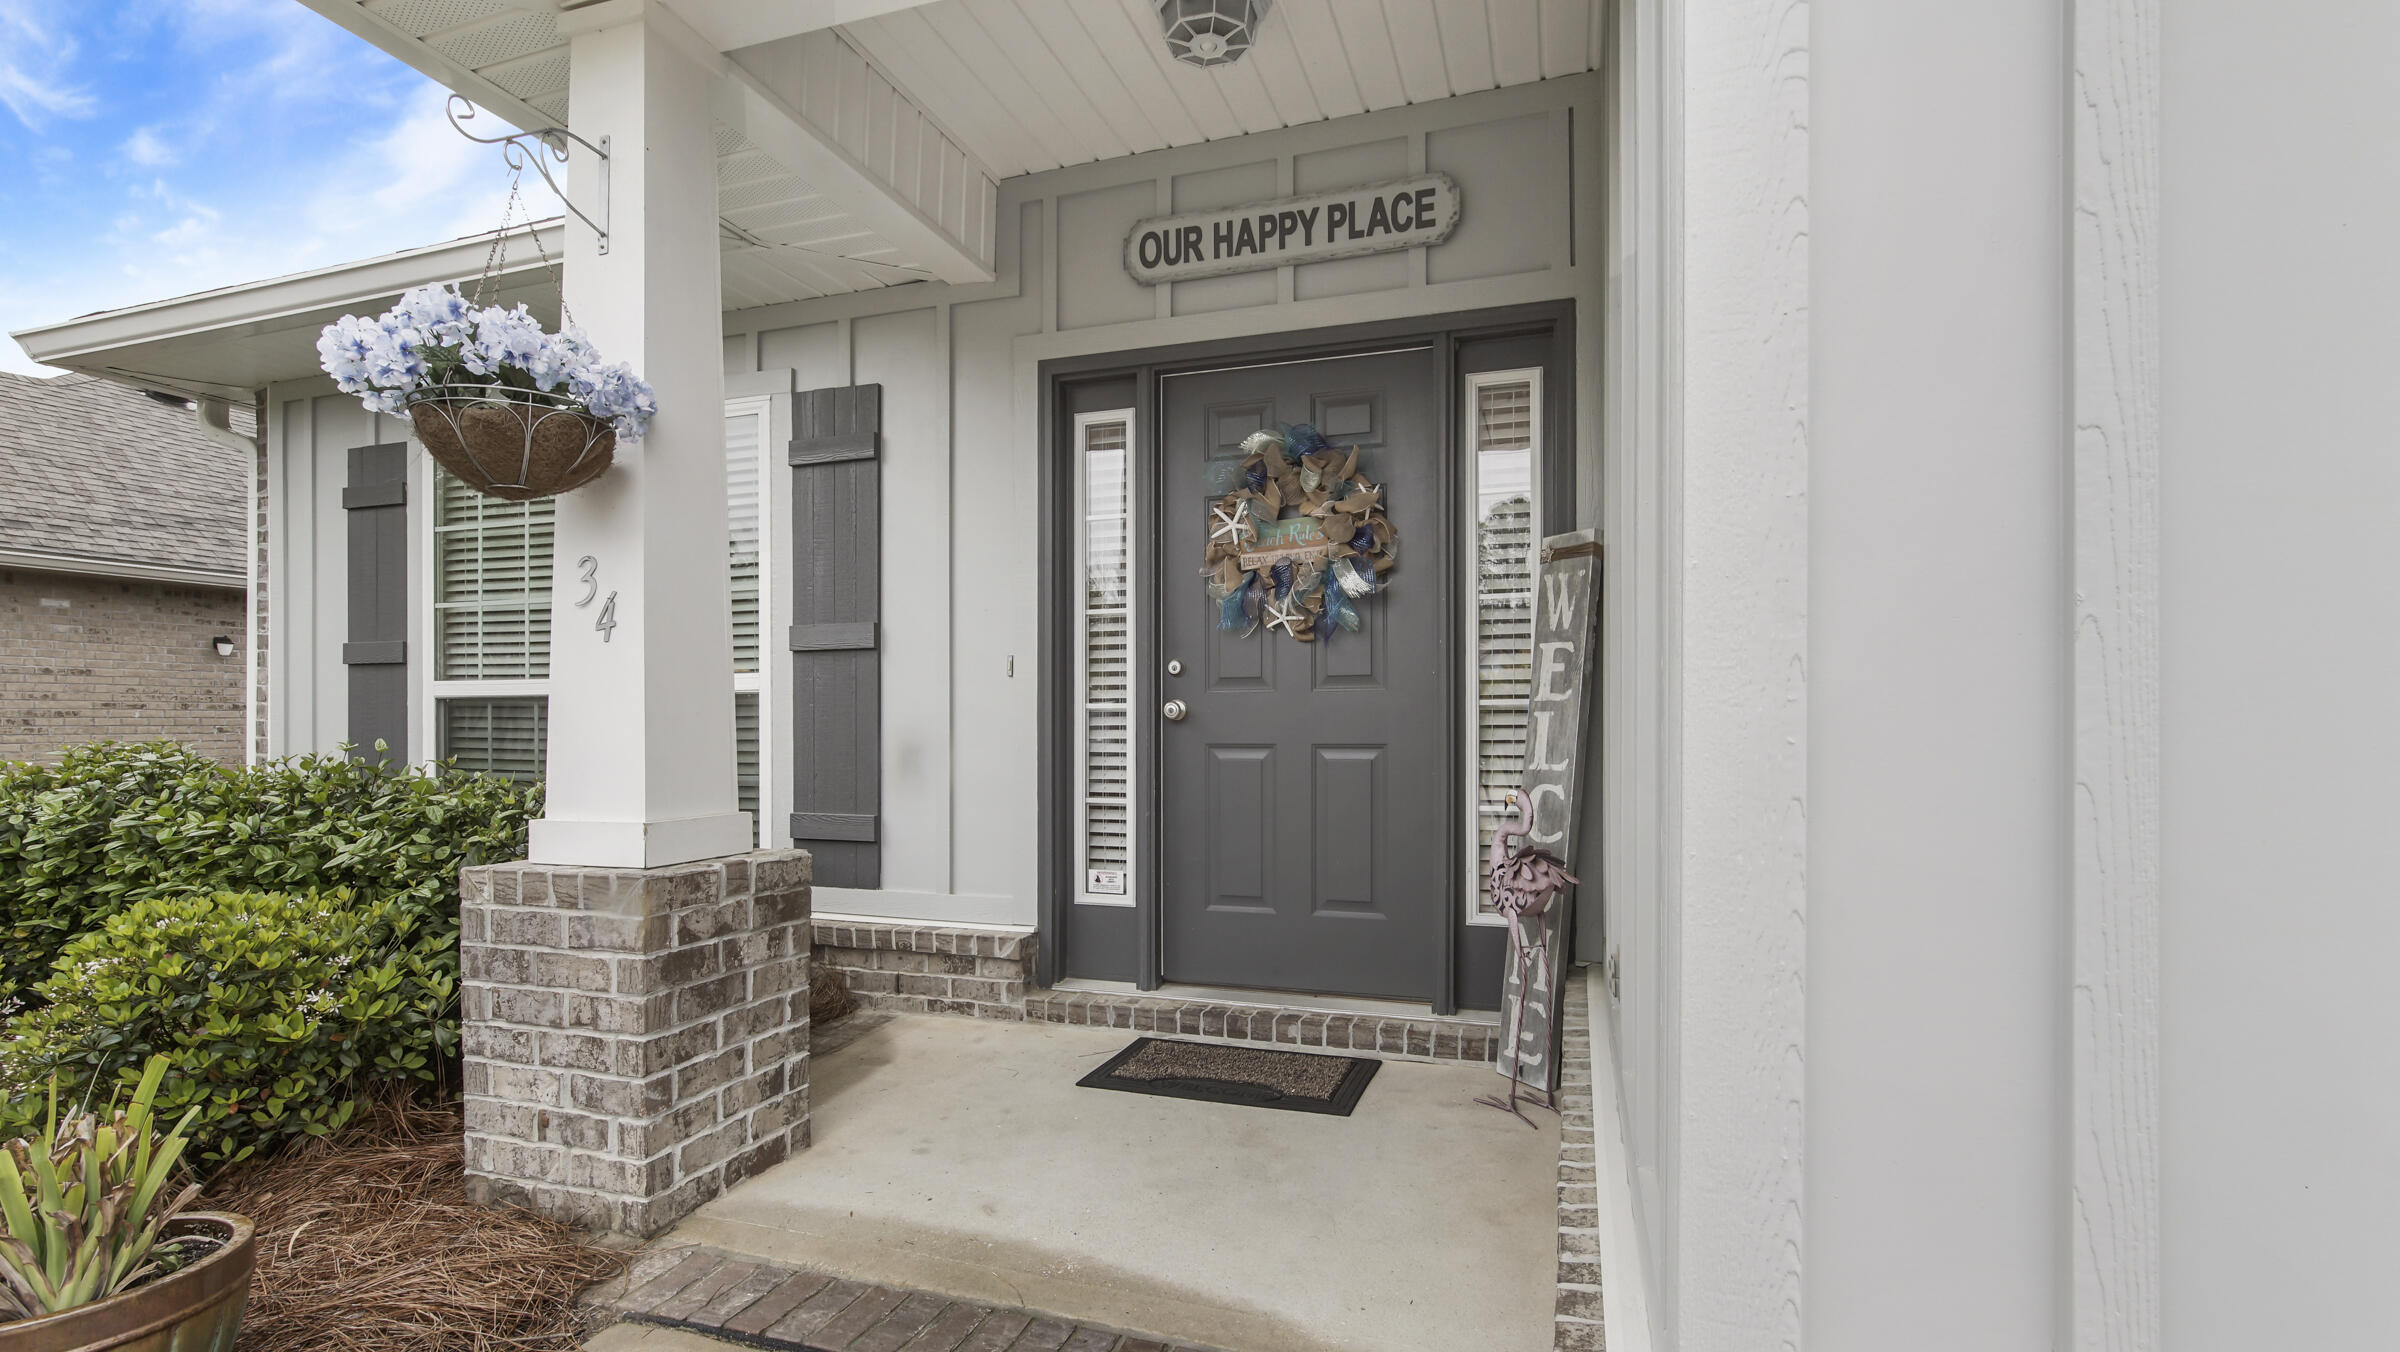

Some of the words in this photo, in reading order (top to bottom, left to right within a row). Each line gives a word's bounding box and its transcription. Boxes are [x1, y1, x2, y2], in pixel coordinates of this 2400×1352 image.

[1138, 225, 1205, 269] OUR
[1213, 207, 1320, 260] HAPPY
[1327, 187, 1437, 243] PLACE
[1503, 569, 1586, 1066] WELCME
